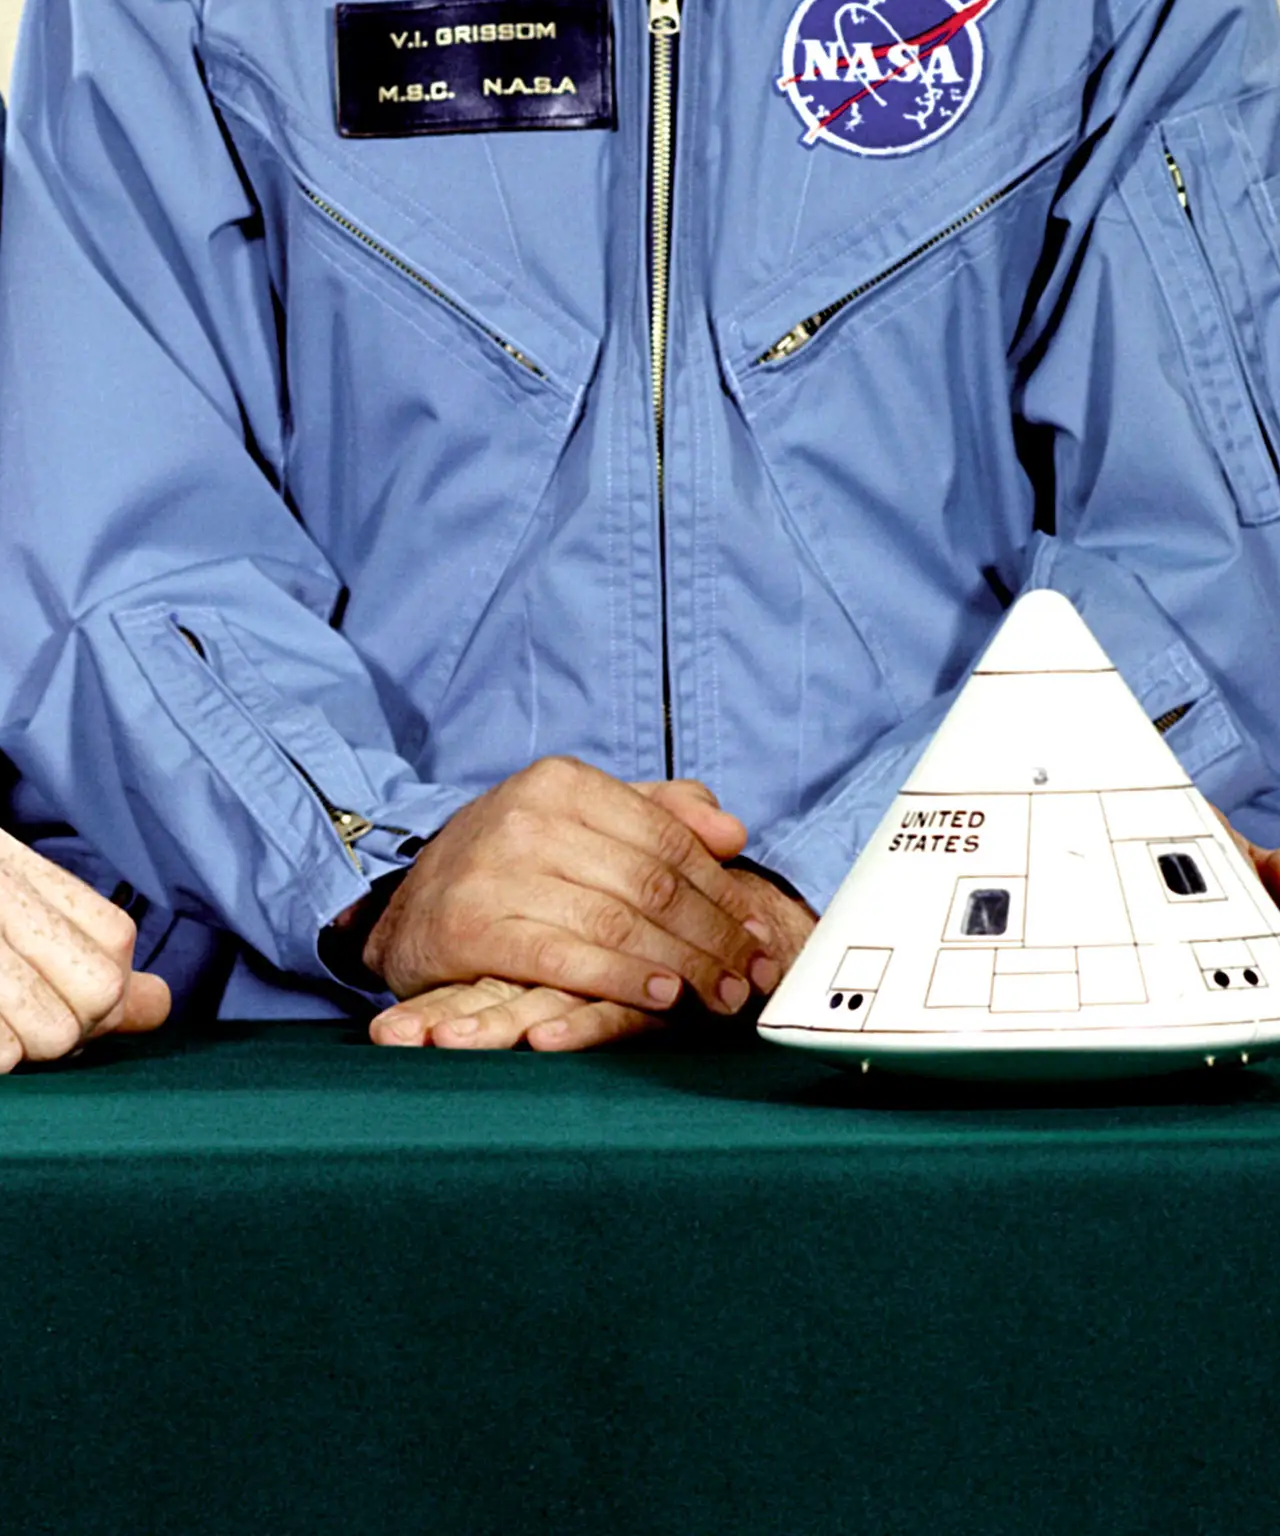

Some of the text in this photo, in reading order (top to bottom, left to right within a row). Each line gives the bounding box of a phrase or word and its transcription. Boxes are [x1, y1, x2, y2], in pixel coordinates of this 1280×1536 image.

[390, 22, 556, 49] V.I. GRISSOM
[801, 38, 964, 84] NASA
[378, 81, 455, 103] M.S.C.
[901, 810, 985, 828] UNITED
[888, 833, 979, 852] STATES
